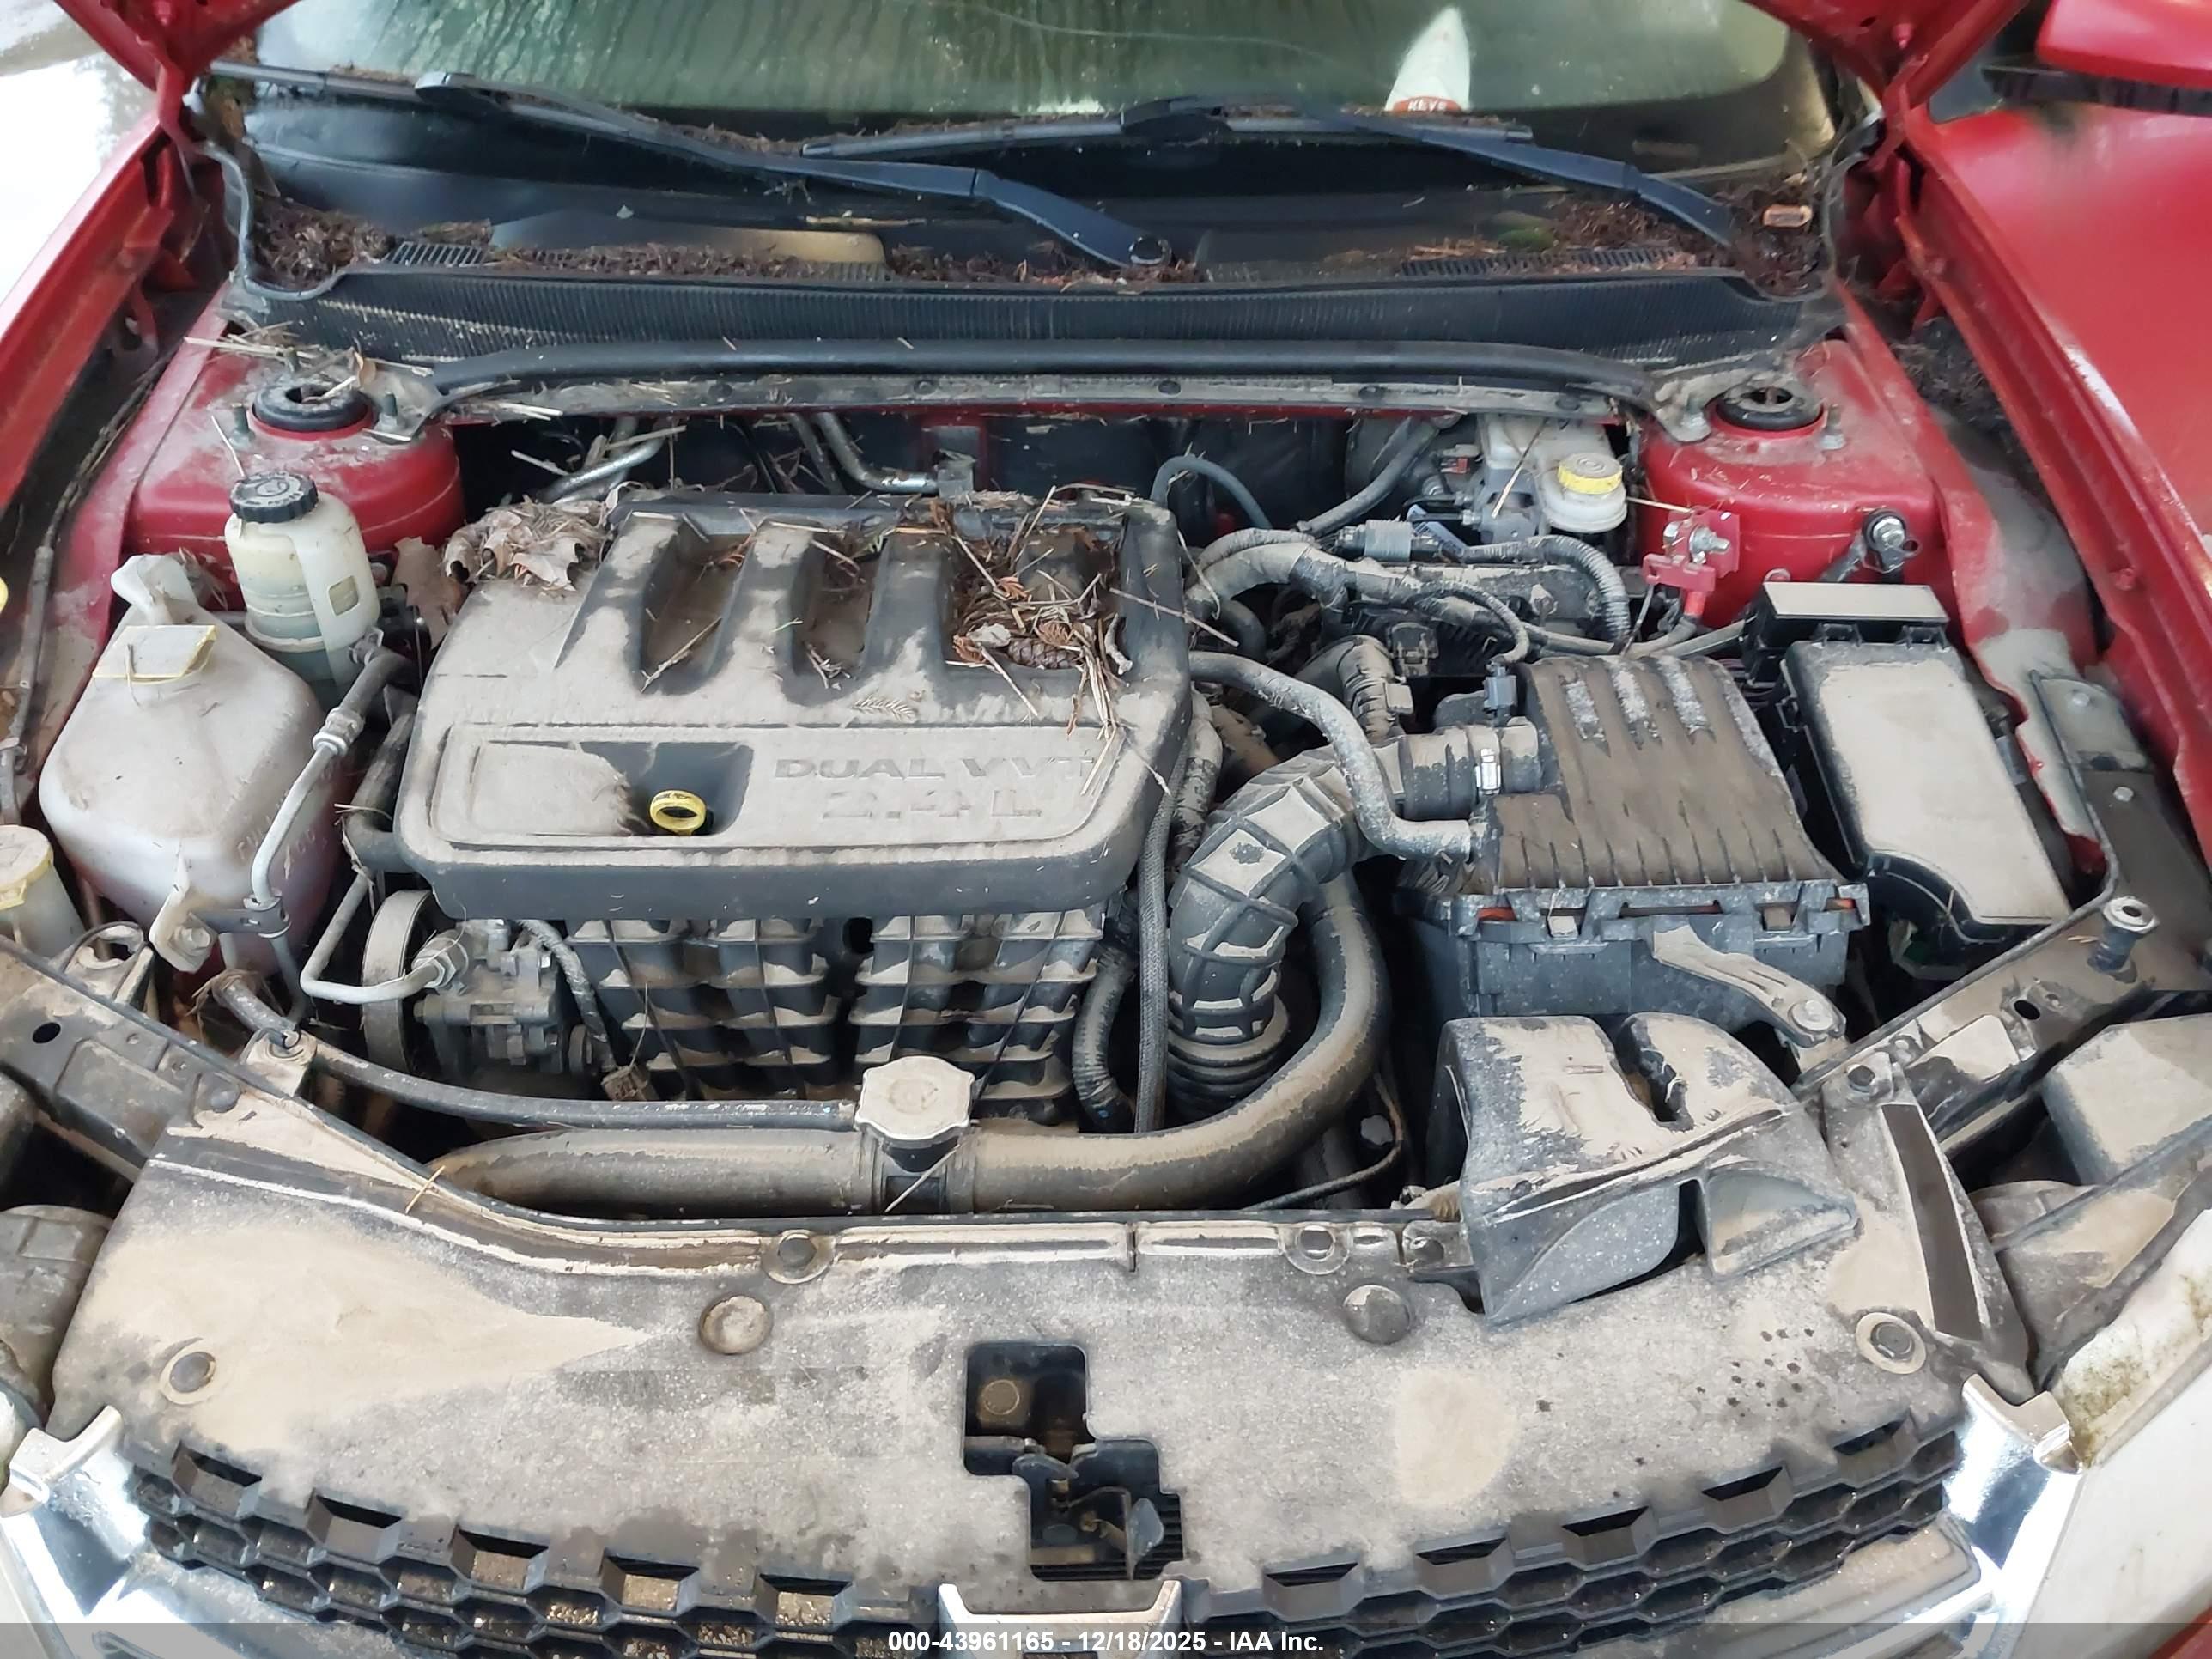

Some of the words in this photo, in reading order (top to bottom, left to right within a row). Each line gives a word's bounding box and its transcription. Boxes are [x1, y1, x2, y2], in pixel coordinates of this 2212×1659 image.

[775, 758, 946, 780] DUAL
[961, 757, 1094, 778] VVT
[822, 789, 1042, 820] 2.4L
